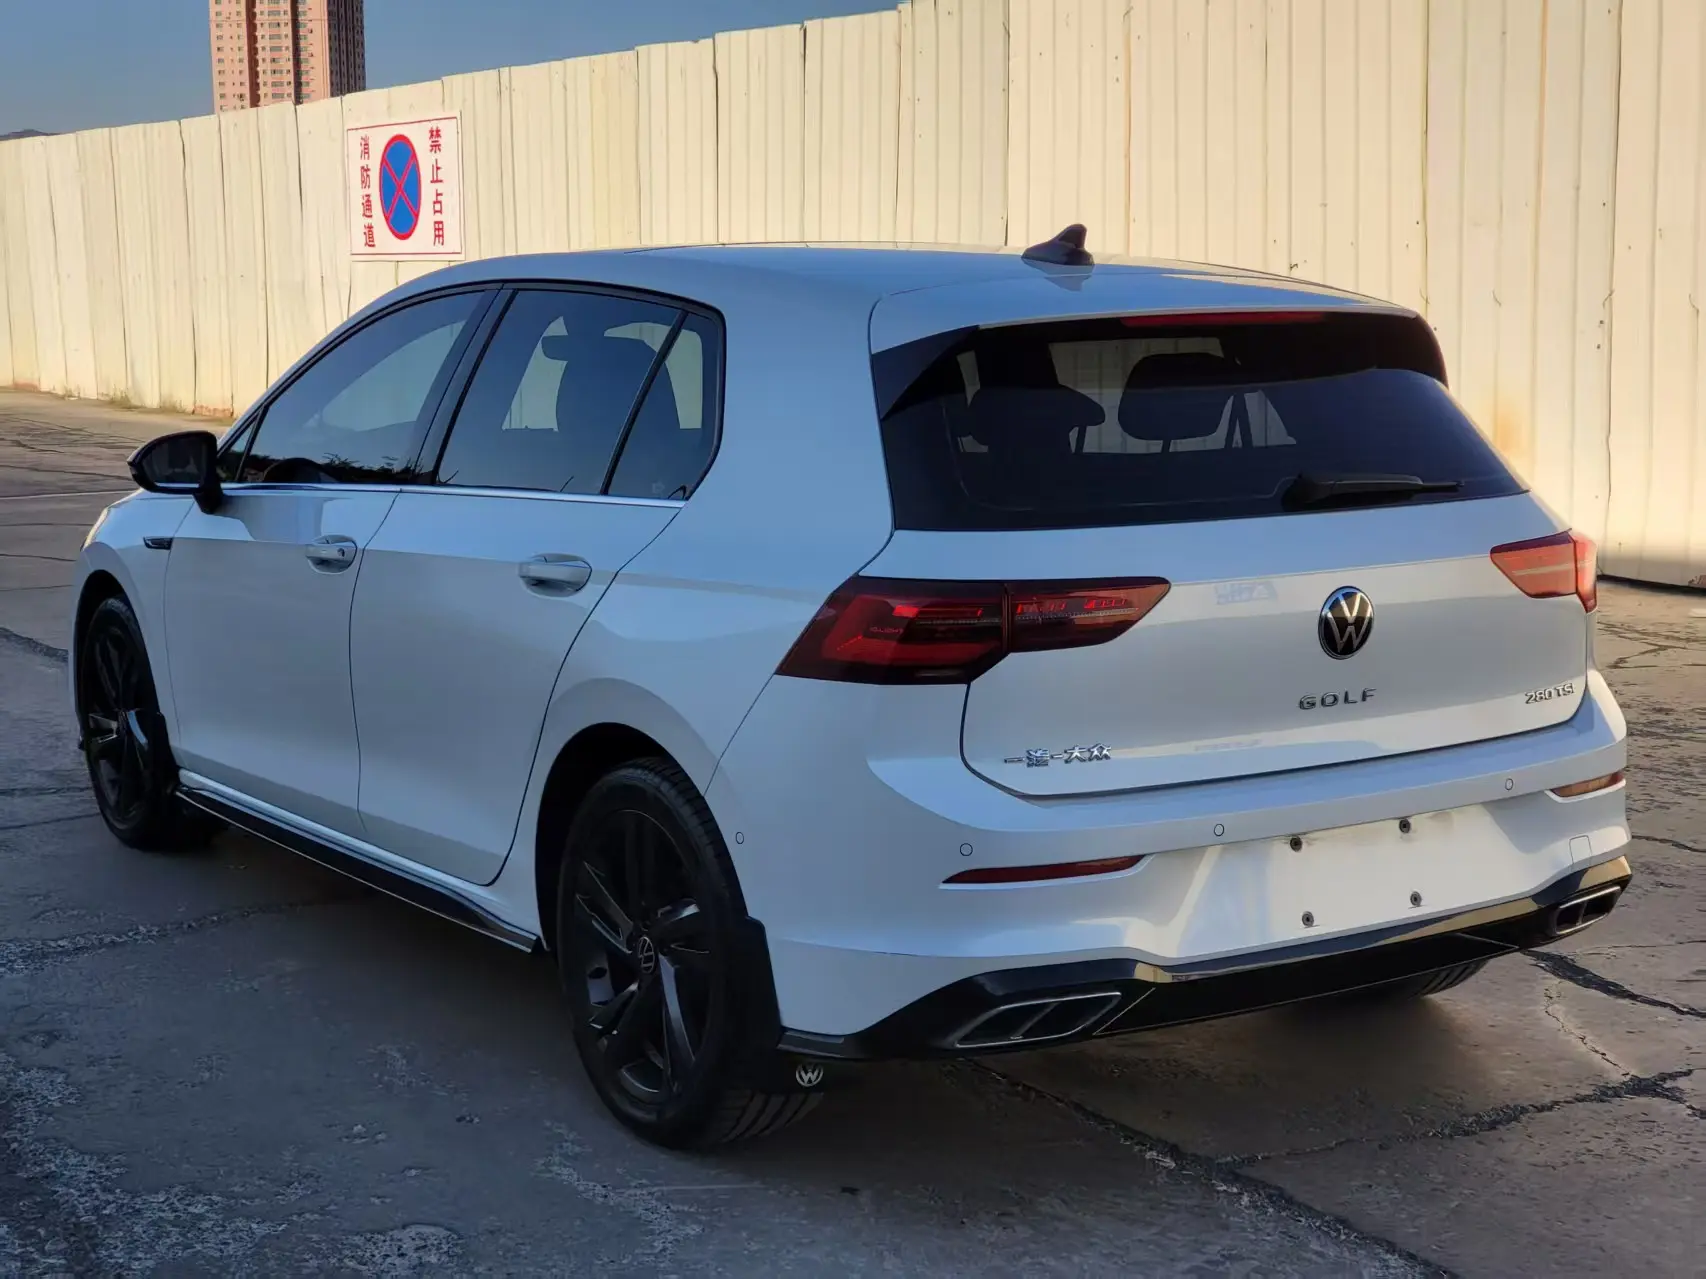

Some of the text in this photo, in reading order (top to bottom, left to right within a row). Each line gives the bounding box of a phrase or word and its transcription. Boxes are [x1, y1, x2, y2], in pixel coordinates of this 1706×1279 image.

[360, 134, 376, 248] 消防通道
[428, 125, 445, 247] 禁止占用
[1299, 687, 1377, 710] GOLF
[1525, 682, 1575, 704] 280 TSI
